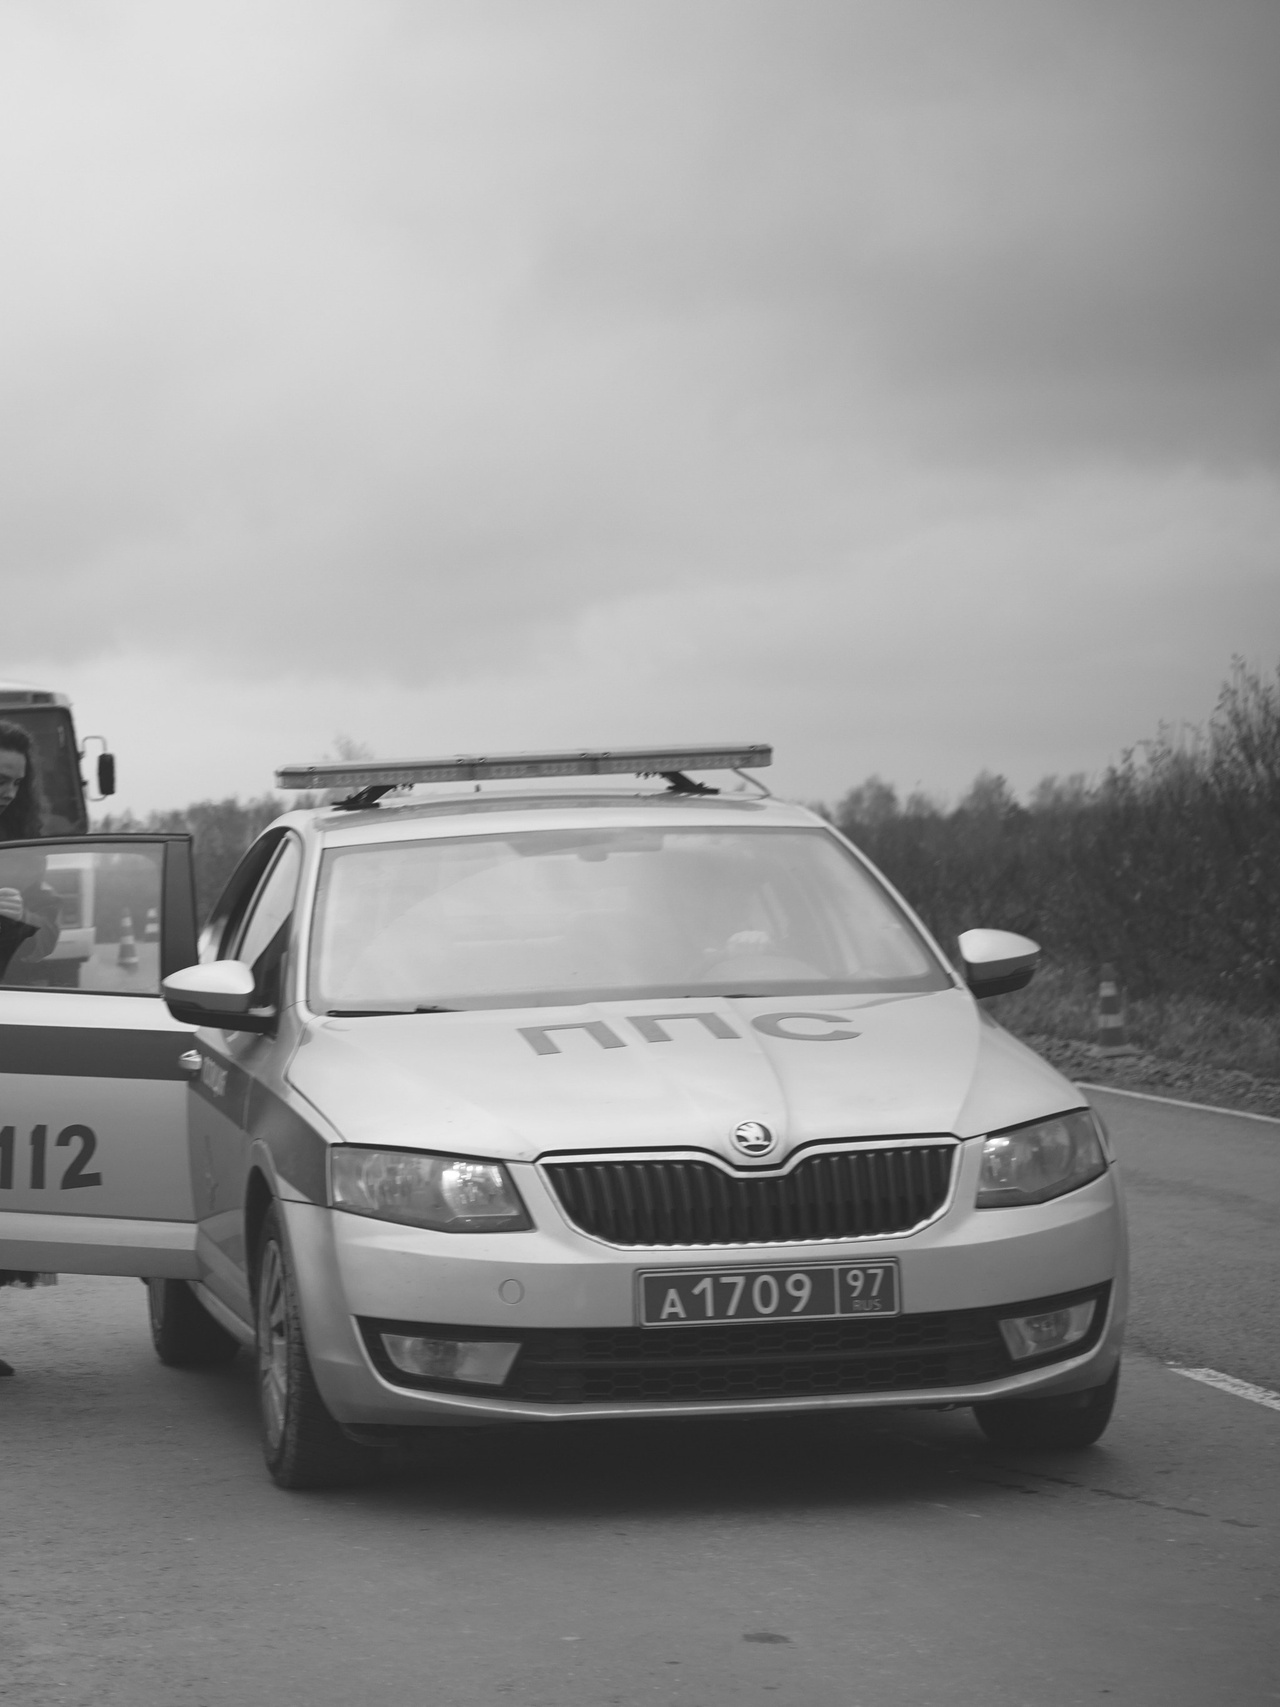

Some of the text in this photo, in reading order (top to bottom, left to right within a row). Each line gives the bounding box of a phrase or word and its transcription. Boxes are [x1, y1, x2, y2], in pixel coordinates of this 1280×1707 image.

[516, 1012, 863, 1055] ППС
[846, 1269, 884, 1297] 97
[852, 1299, 882, 1311] RUS
